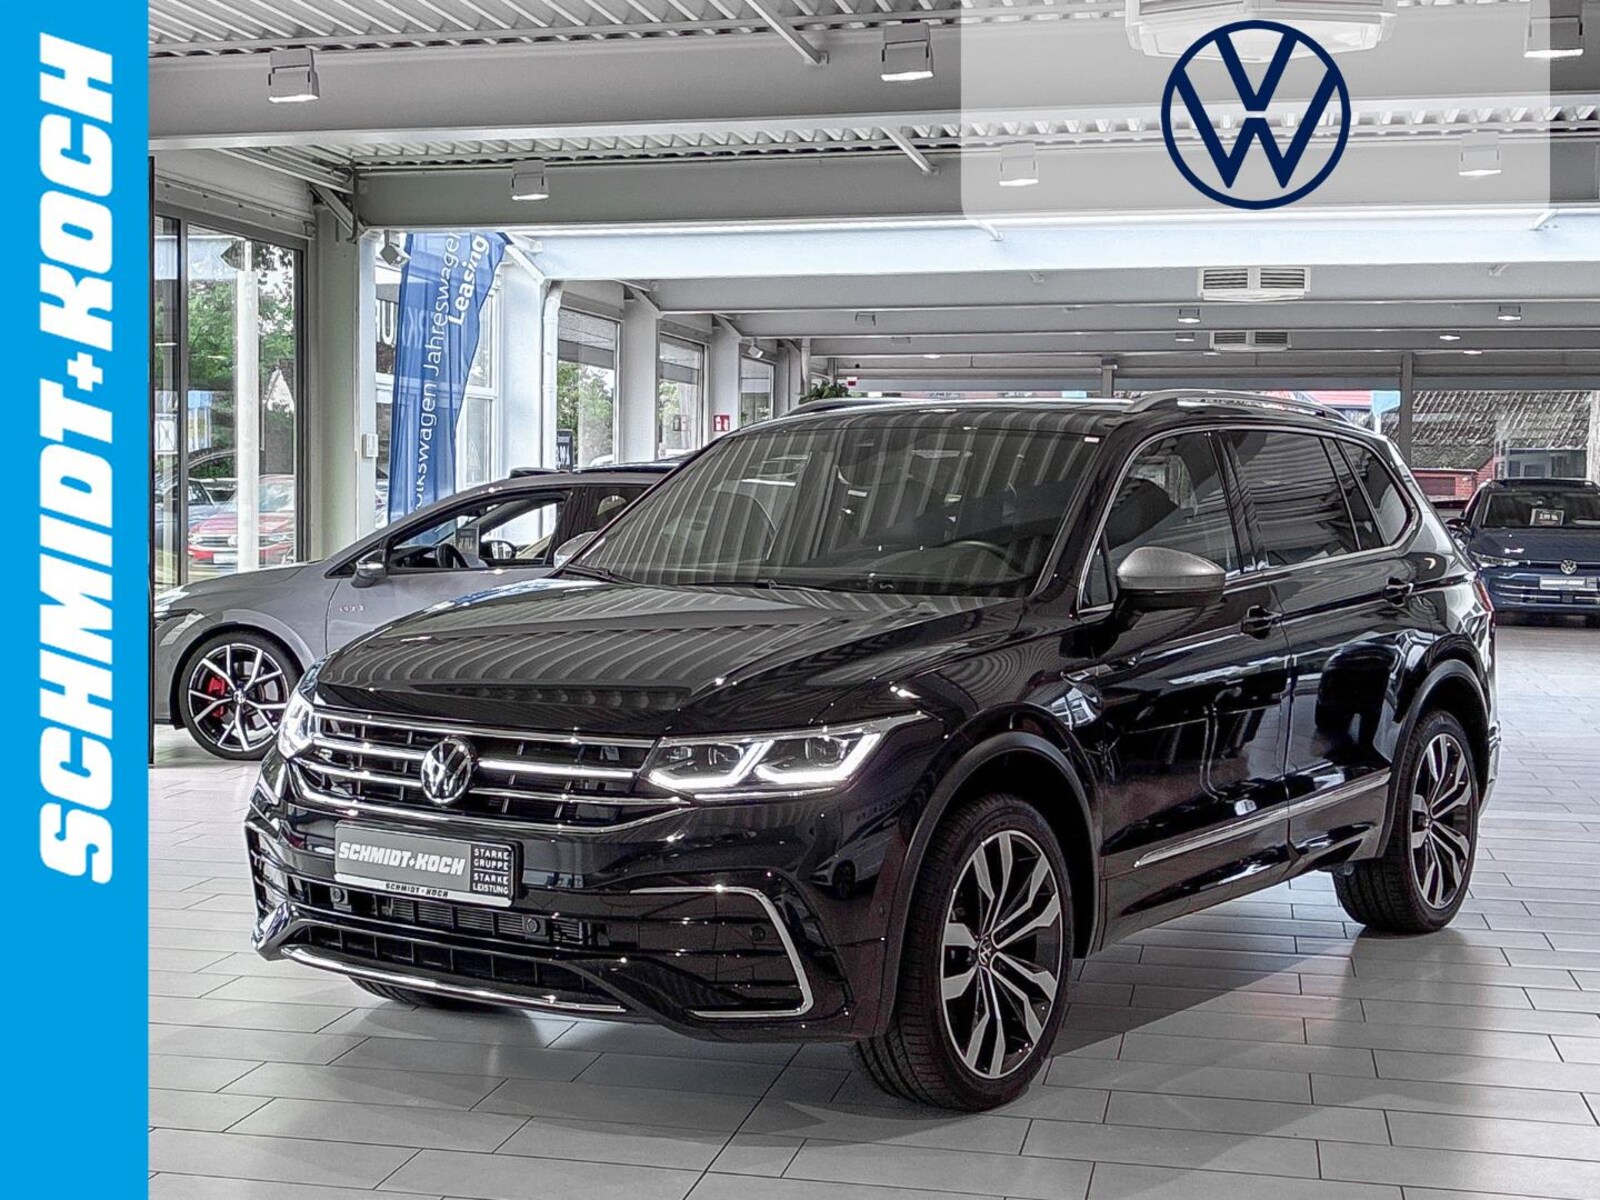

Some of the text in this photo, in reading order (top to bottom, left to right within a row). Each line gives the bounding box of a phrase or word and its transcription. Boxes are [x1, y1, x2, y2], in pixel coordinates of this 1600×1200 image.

[448, 235, 490, 325] Leasing
[415, 382, 438, 510] olkswagen
[338, 842, 467, 877] SCHMIDT+KOCH
[473, 848, 509, 860] STARKE
[473, 858, 509, 871] GRUPPE
[473, 872, 509, 885] STARKE
[472, 882, 509, 895] LEISTUNG
